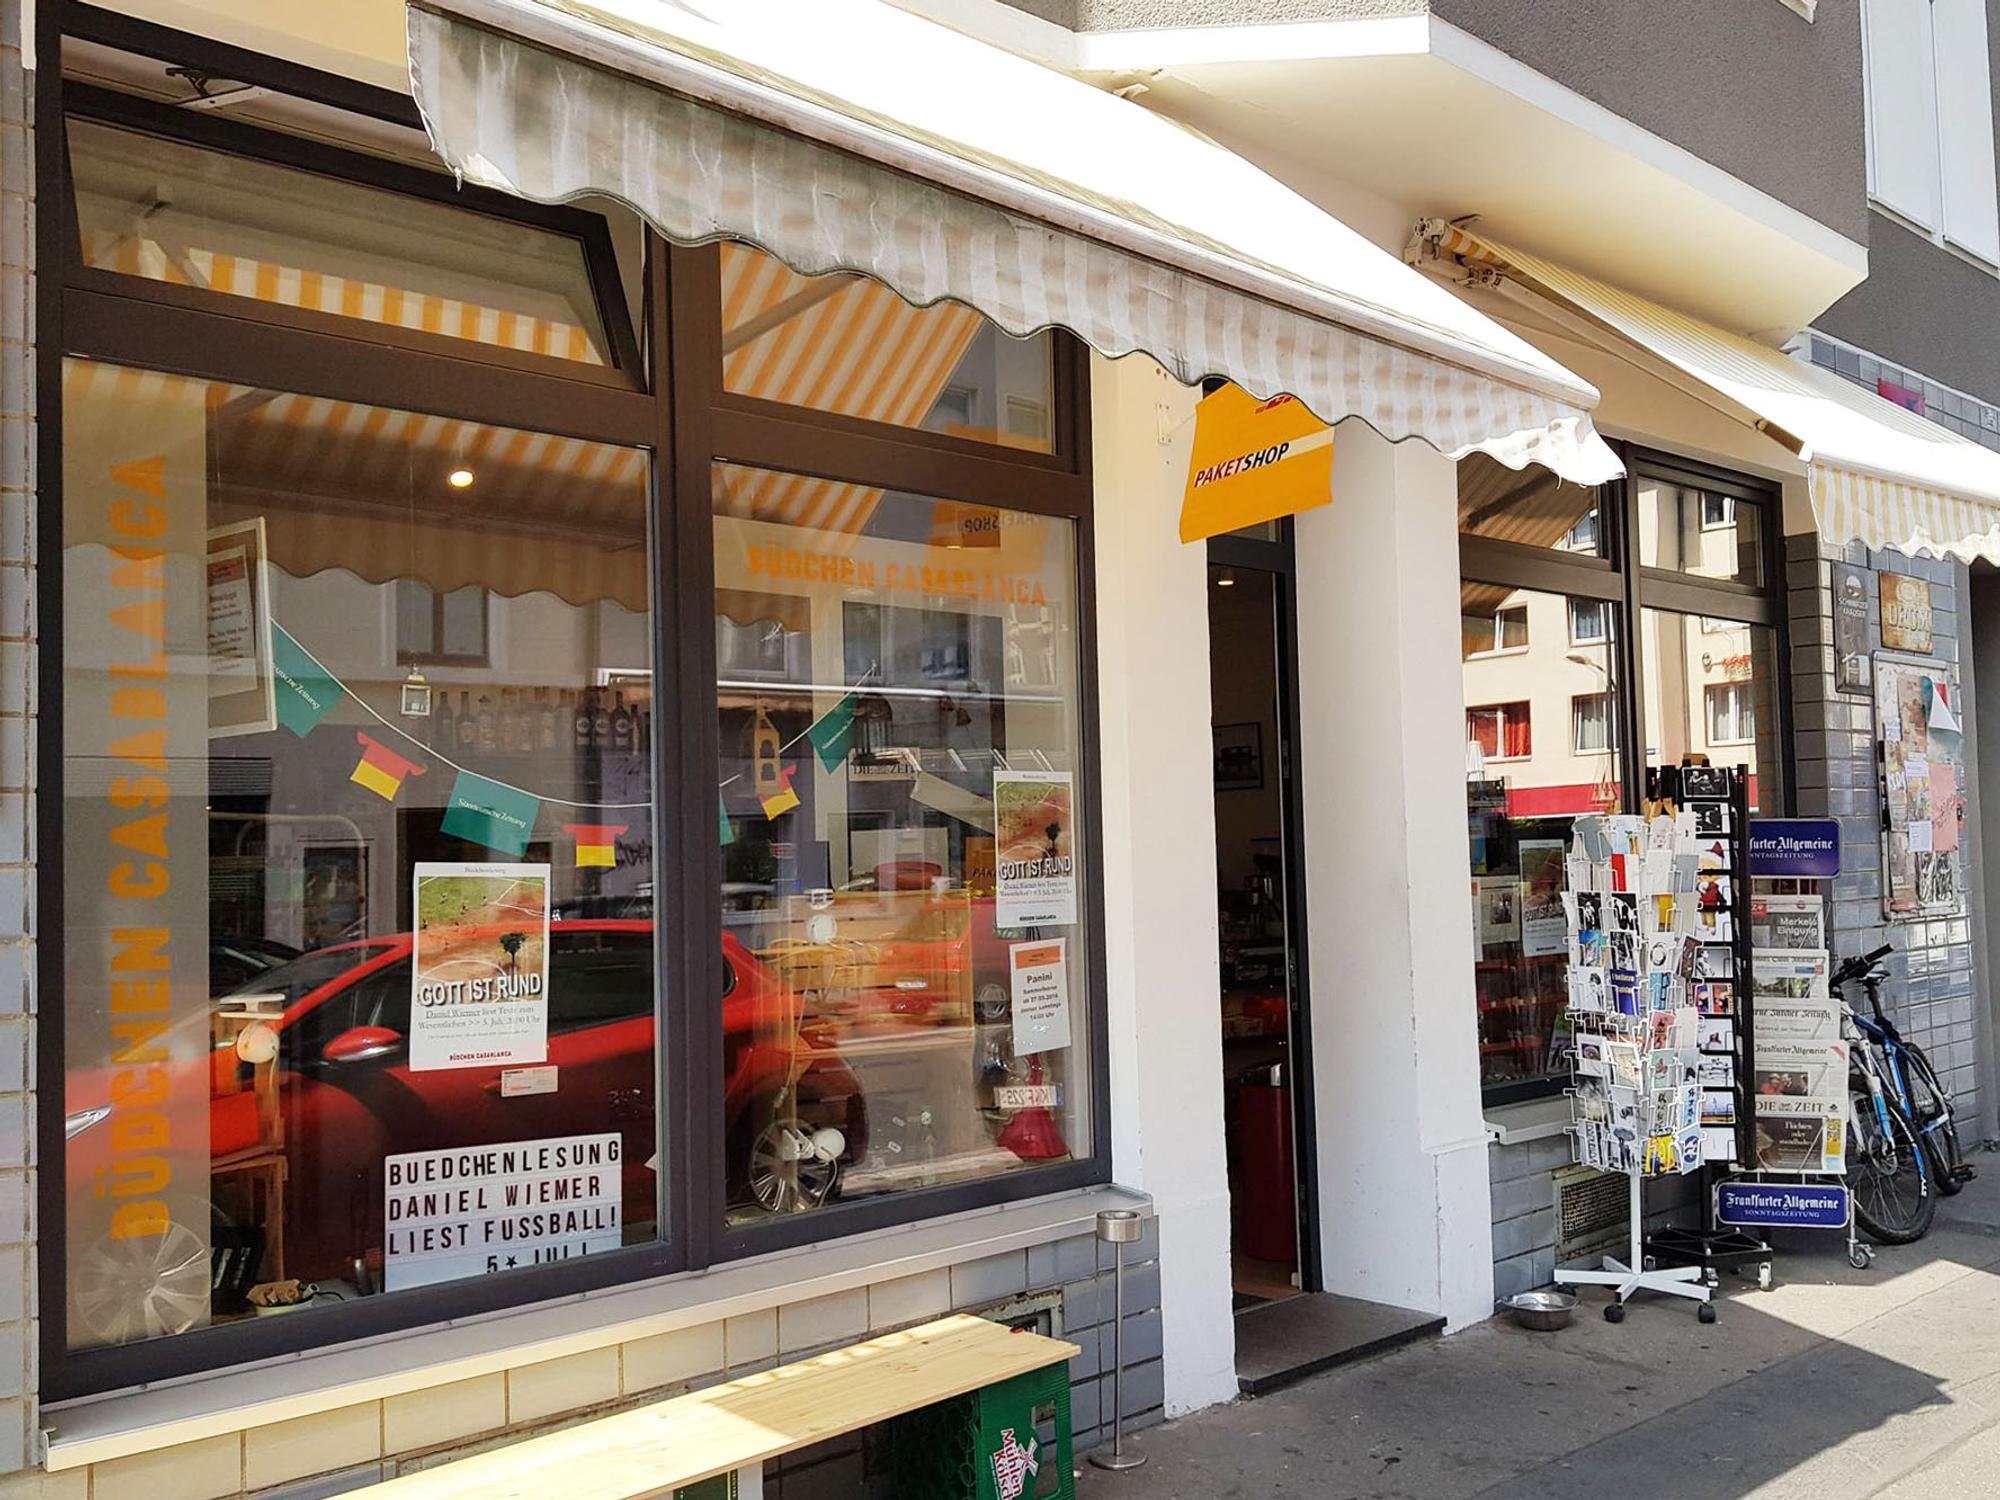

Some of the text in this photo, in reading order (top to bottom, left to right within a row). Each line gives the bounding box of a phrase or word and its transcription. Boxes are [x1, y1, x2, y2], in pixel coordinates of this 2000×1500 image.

[1194, 442, 1290, 488] PAKETSHOP
[746, 541, 1046, 606] BÜDCHEN CASABLANCA
[108, 456, 171, 899] CASABLANCA
[1750, 837, 1833, 852] furter Allgemeine
[1000, 856, 1072, 880] GOTT IST RUND
[420, 973, 542, 1007] GOTT IST RUND
[1026, 972, 1053, 984] Panini
[1755, 1102, 1777, 1112] DIE
[1794, 1102, 1824, 1113] ZEIT
[389, 1140, 619, 1186] BUEDCHENLESUNG
[389, 1176, 600, 1221] DANIEL WIEMER
[1726, 1192, 1839, 1210] Frankfurter Allgemeine
[1744, 1209, 1820, 1218] SONNTAGSZEITUNG
[389, 1206, 615, 1255] LIEST FUSSBALL!
[487, 1255, 498, 1273] 5
[1001, 1429, 1022, 1494] Mühlen
